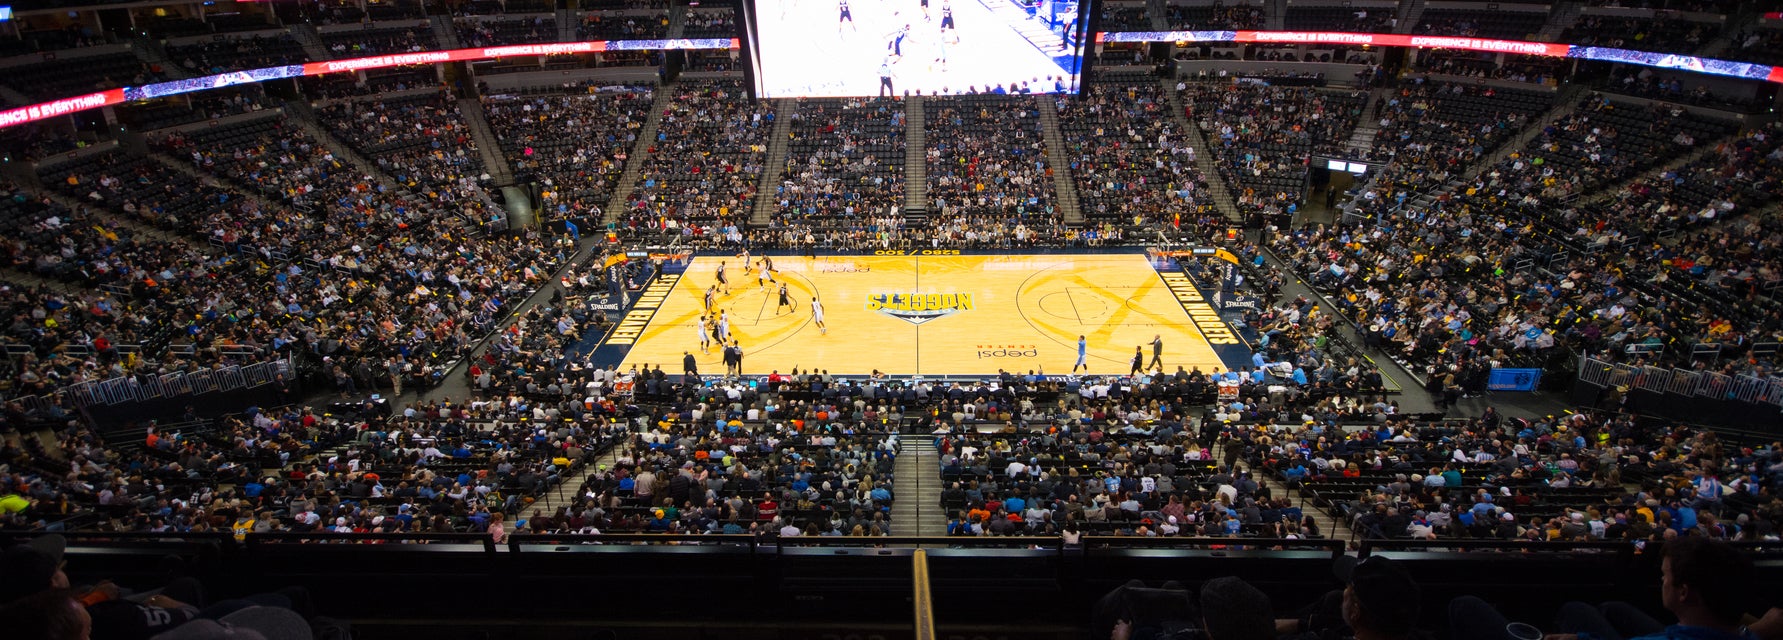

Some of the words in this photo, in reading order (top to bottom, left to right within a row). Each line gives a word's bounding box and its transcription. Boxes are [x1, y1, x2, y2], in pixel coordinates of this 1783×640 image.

[1256, 32, 1306, 41] EXPERIENCE
[1308, 33, 1316, 41] IS
[1317, 33, 1373, 43] EVERYTHING
[1411, 37, 1471, 48] EXPERIENCE
[1472, 39, 1481, 48] IS
[1482, 40, 1547, 53] EVERYTHING
[328, 58, 384, 71] EXPERIENCE
[384, 56, 393, 64] IS
[394, 52, 449, 64] EVERYTHING
[28, 106, 40, 118] IS
[41, 93, 106, 116] EVERYTHING
[591, 303, 619, 311] SPALDING
[605, 309, 656, 345] DENVER
[633, 274, 680, 308] NUGGETS
[866, 293, 974, 311] NUGGETS
[1160, 272, 1204, 302] DENVER
[1182, 302, 1239, 344] NUGGETS
[1225, 300, 1255, 308] SPALDING
[977, 349, 1037, 360] pepsi
[1146, 483, 1152, 491] 15
